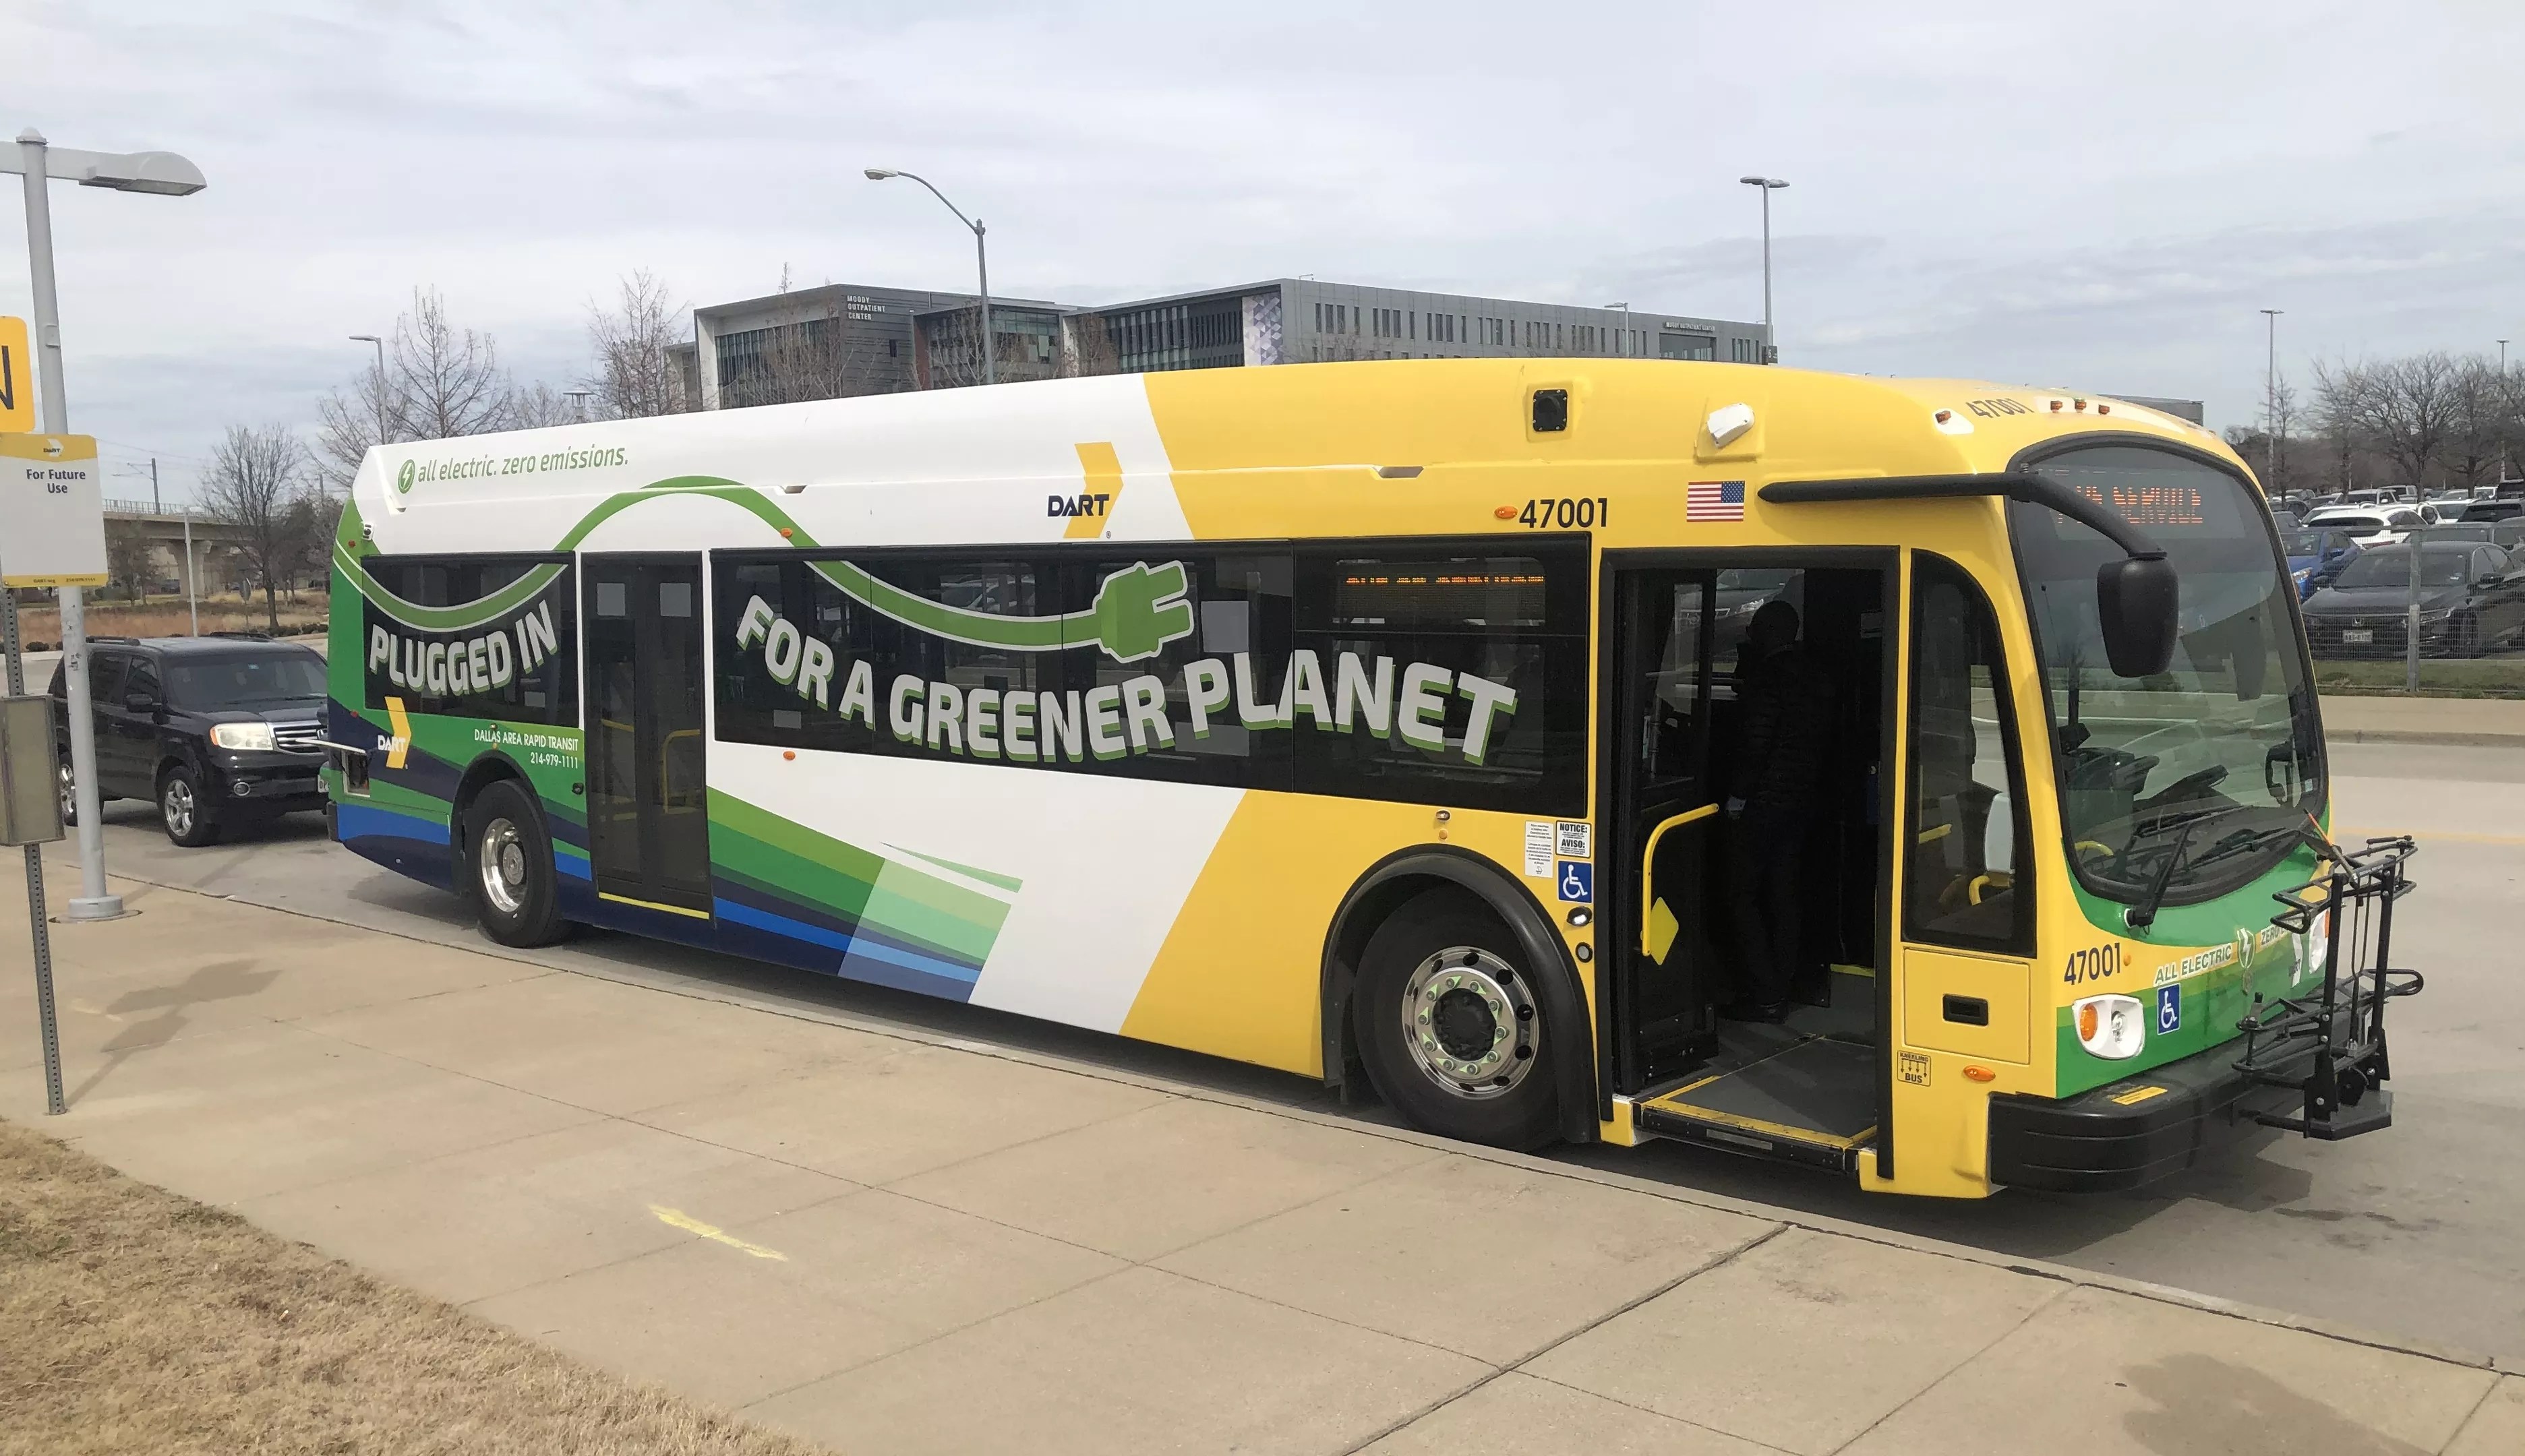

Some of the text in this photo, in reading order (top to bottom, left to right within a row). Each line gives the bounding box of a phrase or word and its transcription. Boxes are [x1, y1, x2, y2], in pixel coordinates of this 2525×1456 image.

[848, 303, 886, 312] OUTPATIENT
[848, 312, 872, 320] CENTER
[1965, 398, 2035, 419] 47001
[419, 444, 628, 482] all electric. zero emissions.
[26, 469, 86, 480] For Future
[47, 483, 68, 493] Use
[1047, 493, 1110, 517] DART
[1519, 497, 1607, 528] 47001
[369, 599, 558, 696] PLUGGED IN
[736, 595, 1518, 766] FOR A GREENER PLANET
[378, 735, 406, 751] DART
[475, 729, 578, 751] DALLAS AREA RAPID TRANSIT
[530, 752, 578, 769] 214-979-1111
[1559, 823, 1588, 833] NOTICE:
[1562, 839, 1585, 849] AVISO:
[2064, 942, 2120, 985] 47001
[2155, 945, 2232, 984] ALL ELECTRIC
[1900, 1052, 1928, 1062] KNEELING
[1905, 1072, 1923, 1083] BUS
